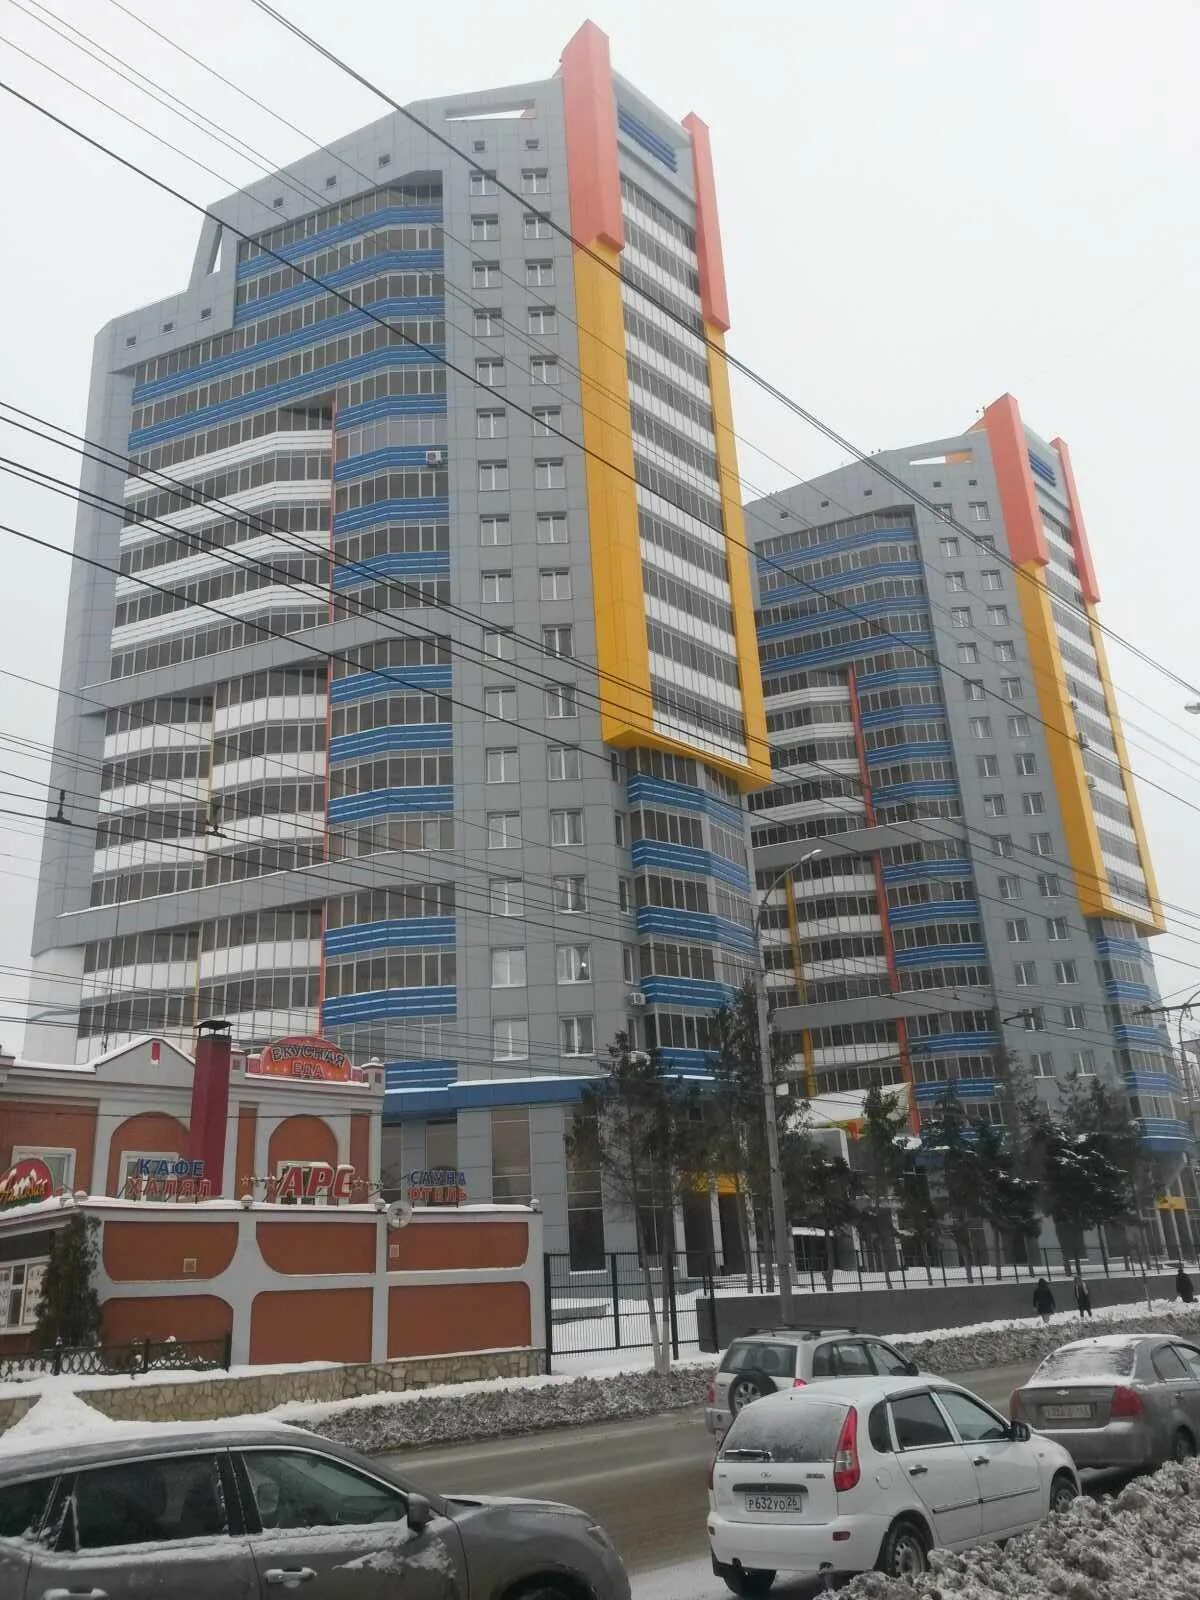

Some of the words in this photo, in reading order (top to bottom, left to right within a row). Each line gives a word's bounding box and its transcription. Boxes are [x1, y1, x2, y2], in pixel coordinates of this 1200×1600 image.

[272, 1044, 345, 1068] ВКУСНАЯ
[292, 1061, 325, 1079] ЕДА
[137, 1158, 205, 1177] КАФЕ
[410, 1169, 466, 1185] САУНА
[126, 1178, 212, 1198] ХАЛЯЛ
[278, 1161, 355, 1198] АРС
